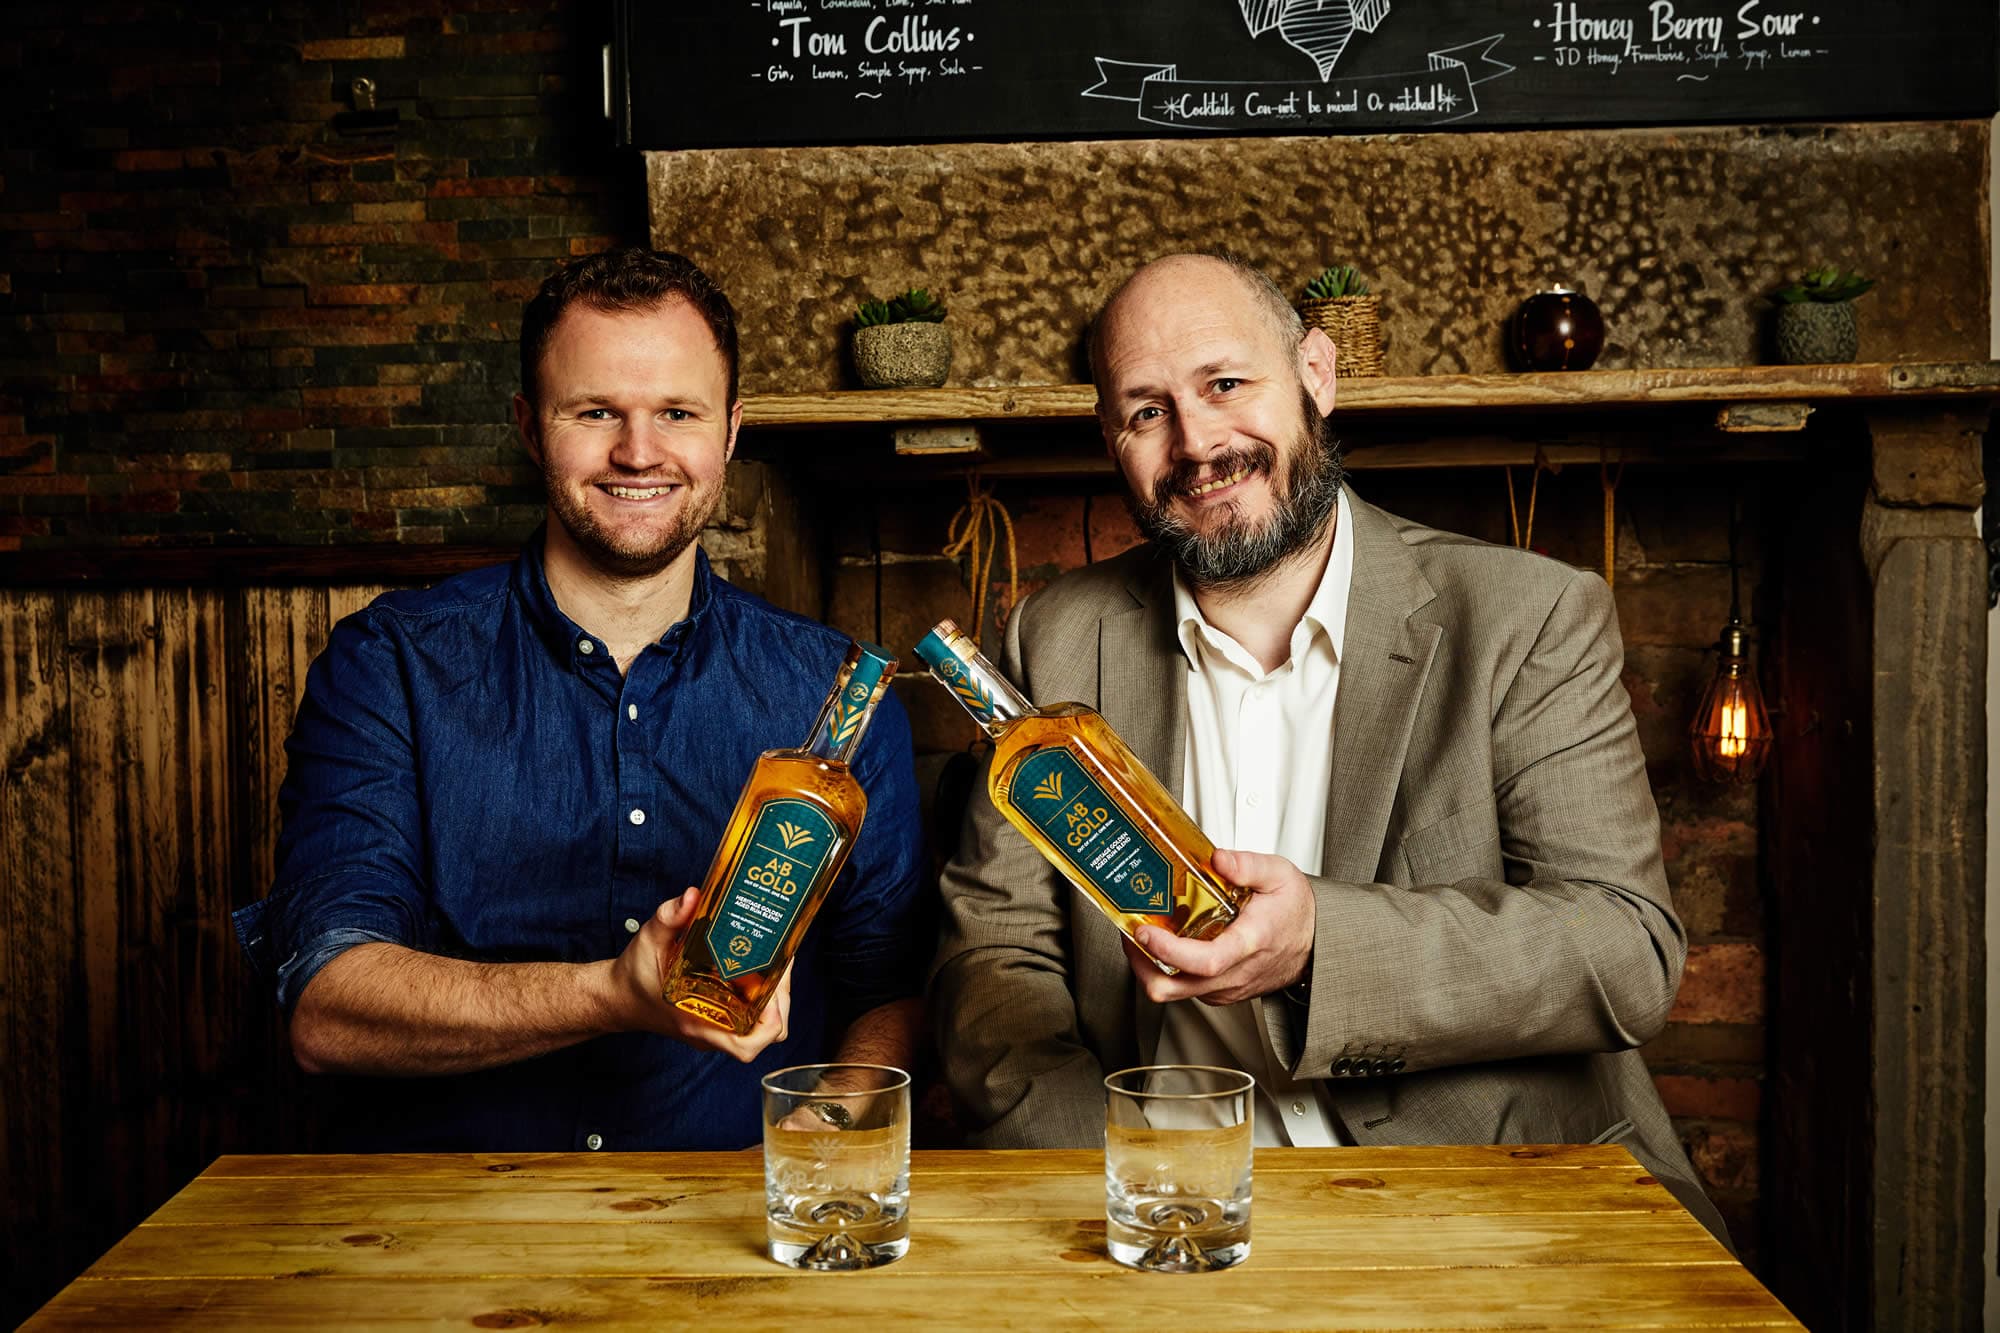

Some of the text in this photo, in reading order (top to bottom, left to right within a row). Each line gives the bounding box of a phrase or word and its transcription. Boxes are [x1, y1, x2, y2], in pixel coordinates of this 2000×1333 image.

[779, 15, 961, 58] Tom Collins
[1548, 0, 1803, 56] Honey Berry Sour
[1781, 42, 1811, 58] Lemon
[767, 65, 794, 82] Gin,
[858, 61, 892, 84] Simple
[940, 58, 966, 76] Soda
[1308, 90, 1322, 114] be
[1327, 88, 1358, 113] mixed
[1367, 93, 1385, 112] Or
[1067, 807, 1109, 847] GOLD
[1109, 831, 1128, 849] GOLDEN
[1106, 849, 1117, 859] RUM
[1115, 836, 1131, 850] BLEND
[747, 866, 797, 895] GOLD
[735, 894, 783, 918] HERITAGE GOLDEN
